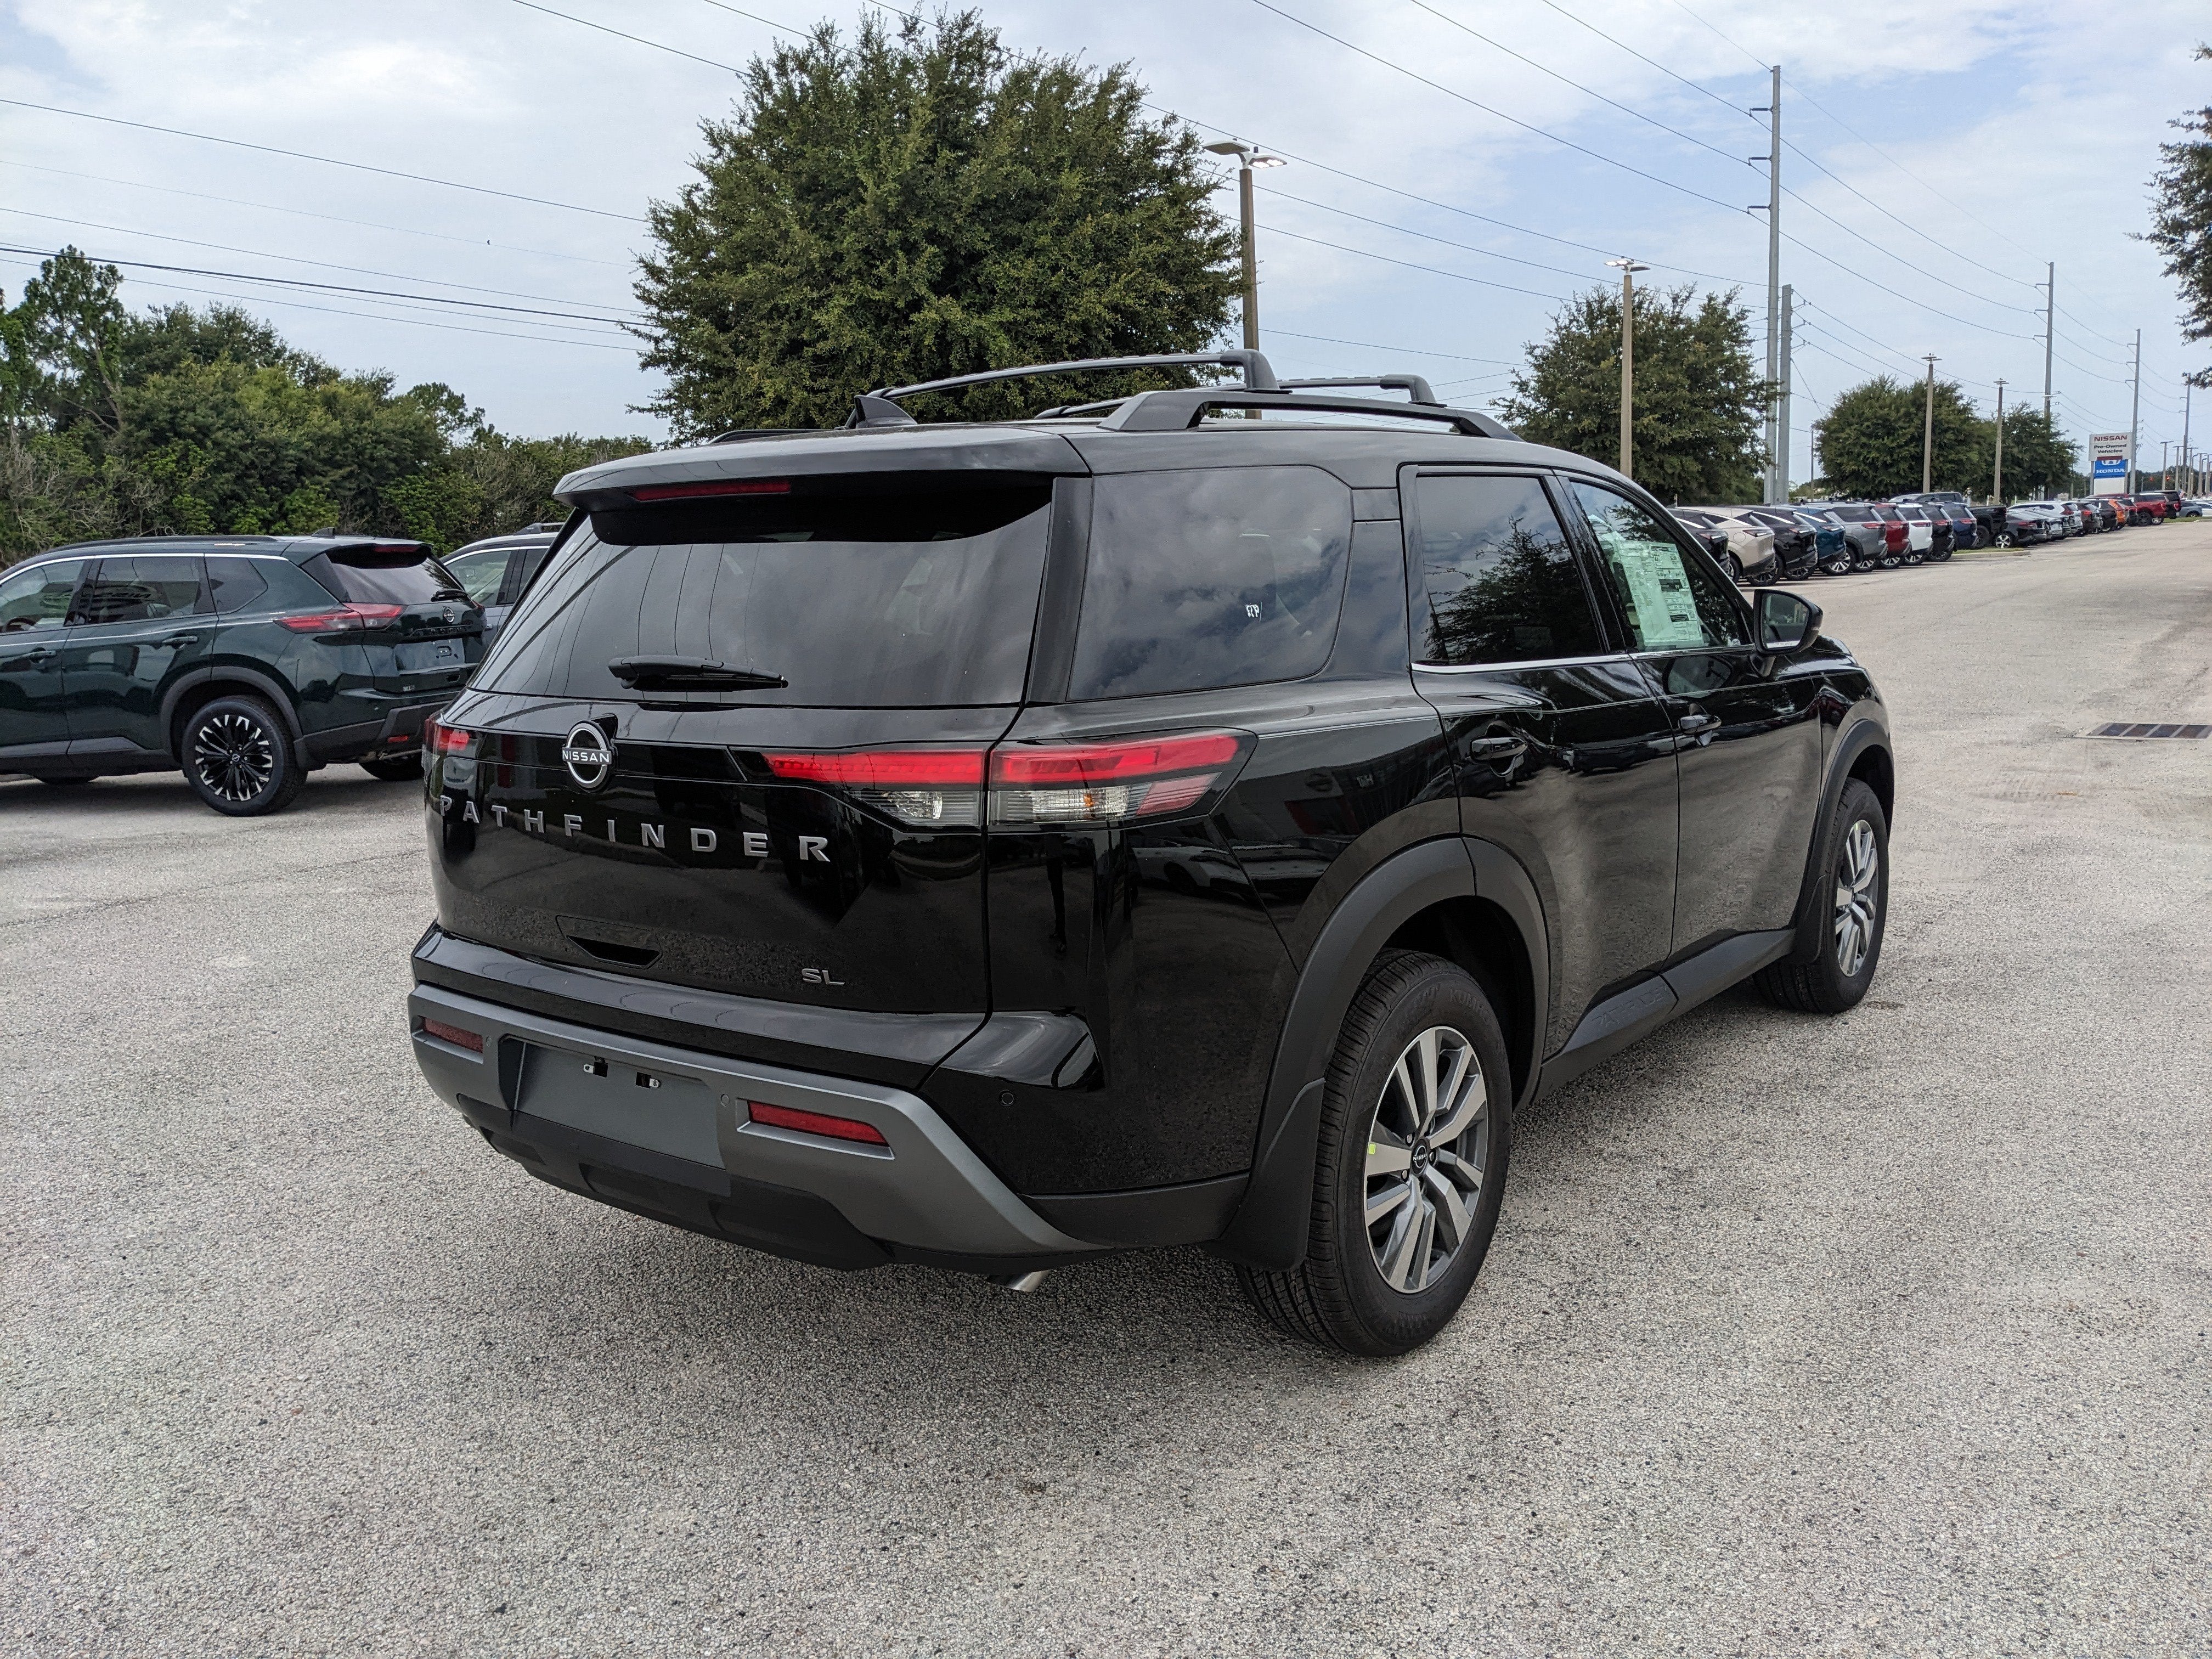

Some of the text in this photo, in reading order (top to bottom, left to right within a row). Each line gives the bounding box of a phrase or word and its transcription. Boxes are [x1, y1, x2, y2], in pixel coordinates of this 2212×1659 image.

[562, 749, 610, 763] NISSAN
[440, 795, 831, 862] PATHFINDER
[802, 968, 845, 986] SL
